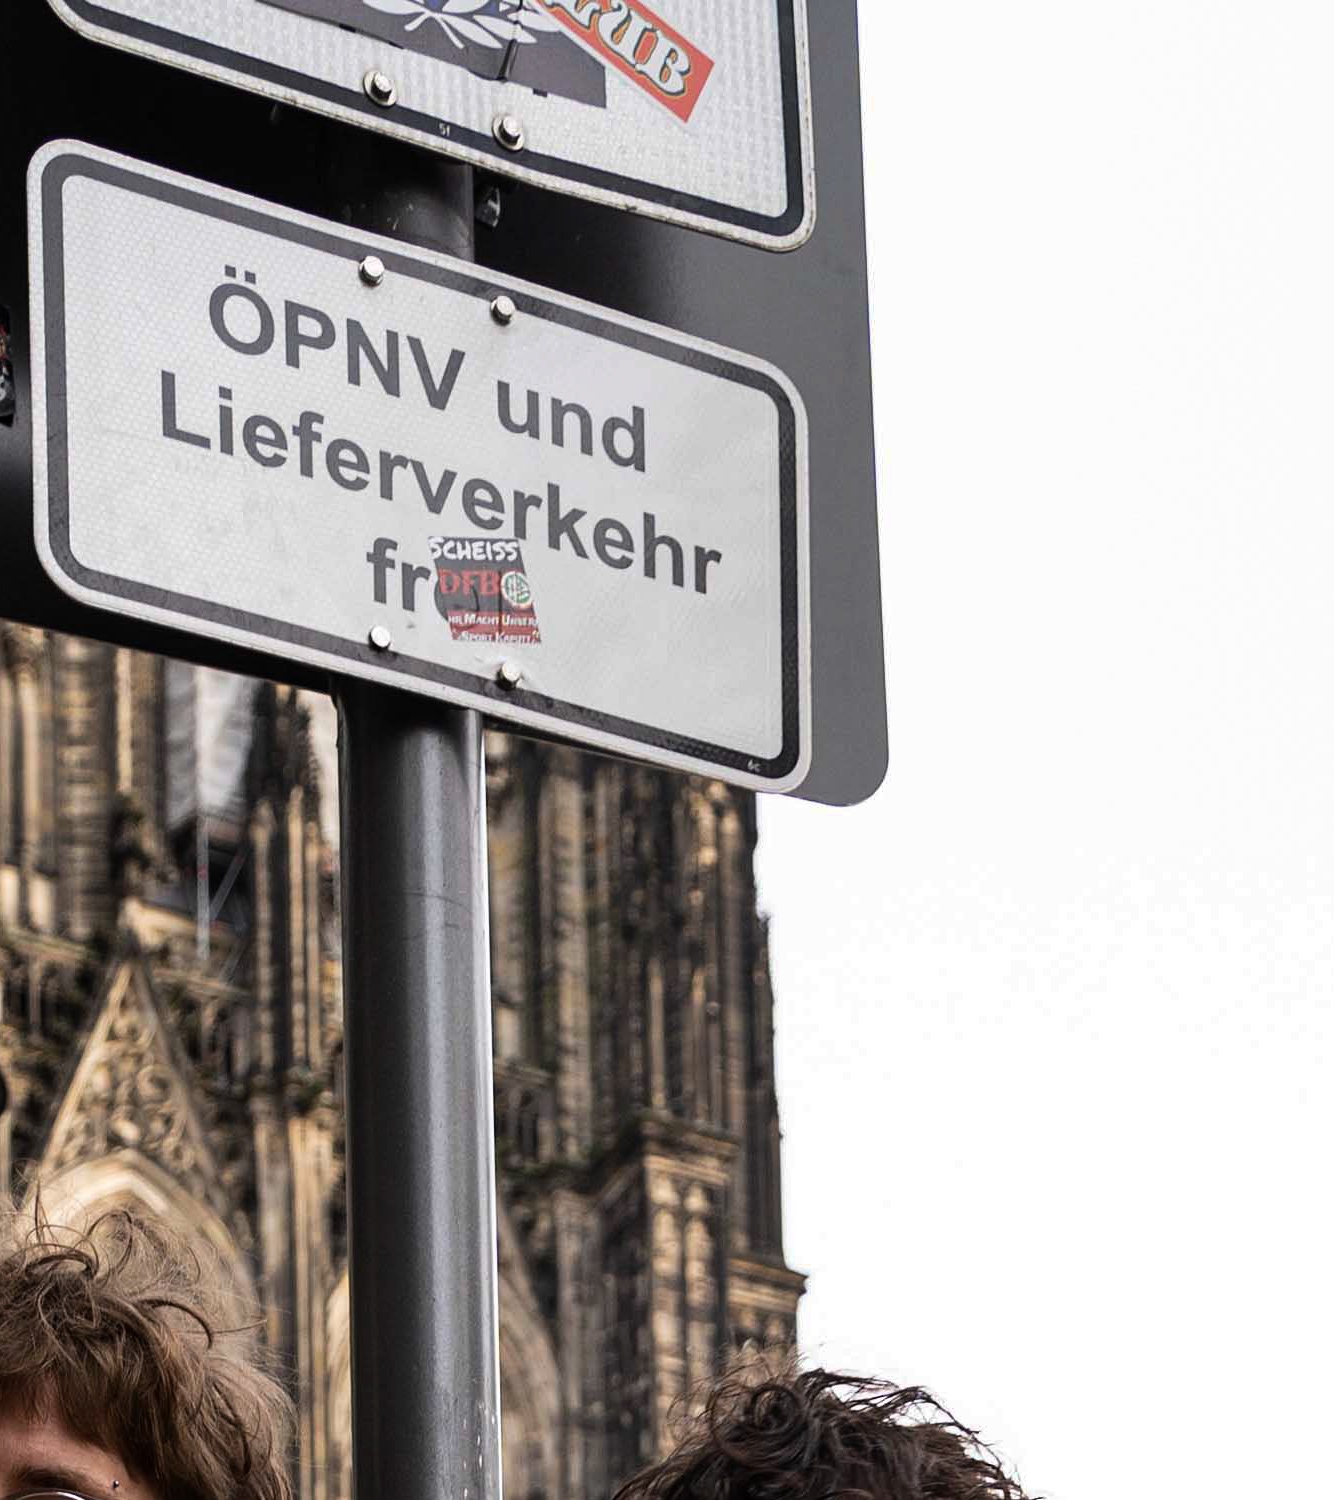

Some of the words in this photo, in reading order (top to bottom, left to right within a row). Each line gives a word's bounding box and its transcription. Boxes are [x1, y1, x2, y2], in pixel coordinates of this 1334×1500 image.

[209, 265, 466, 411] ÖPNV
[496, 380, 647, 473] und
[161, 370, 722, 595] Lieferverkehr
[428, 536, 519, 562] SCHEISS
[439, 566, 501, 597] DFB
